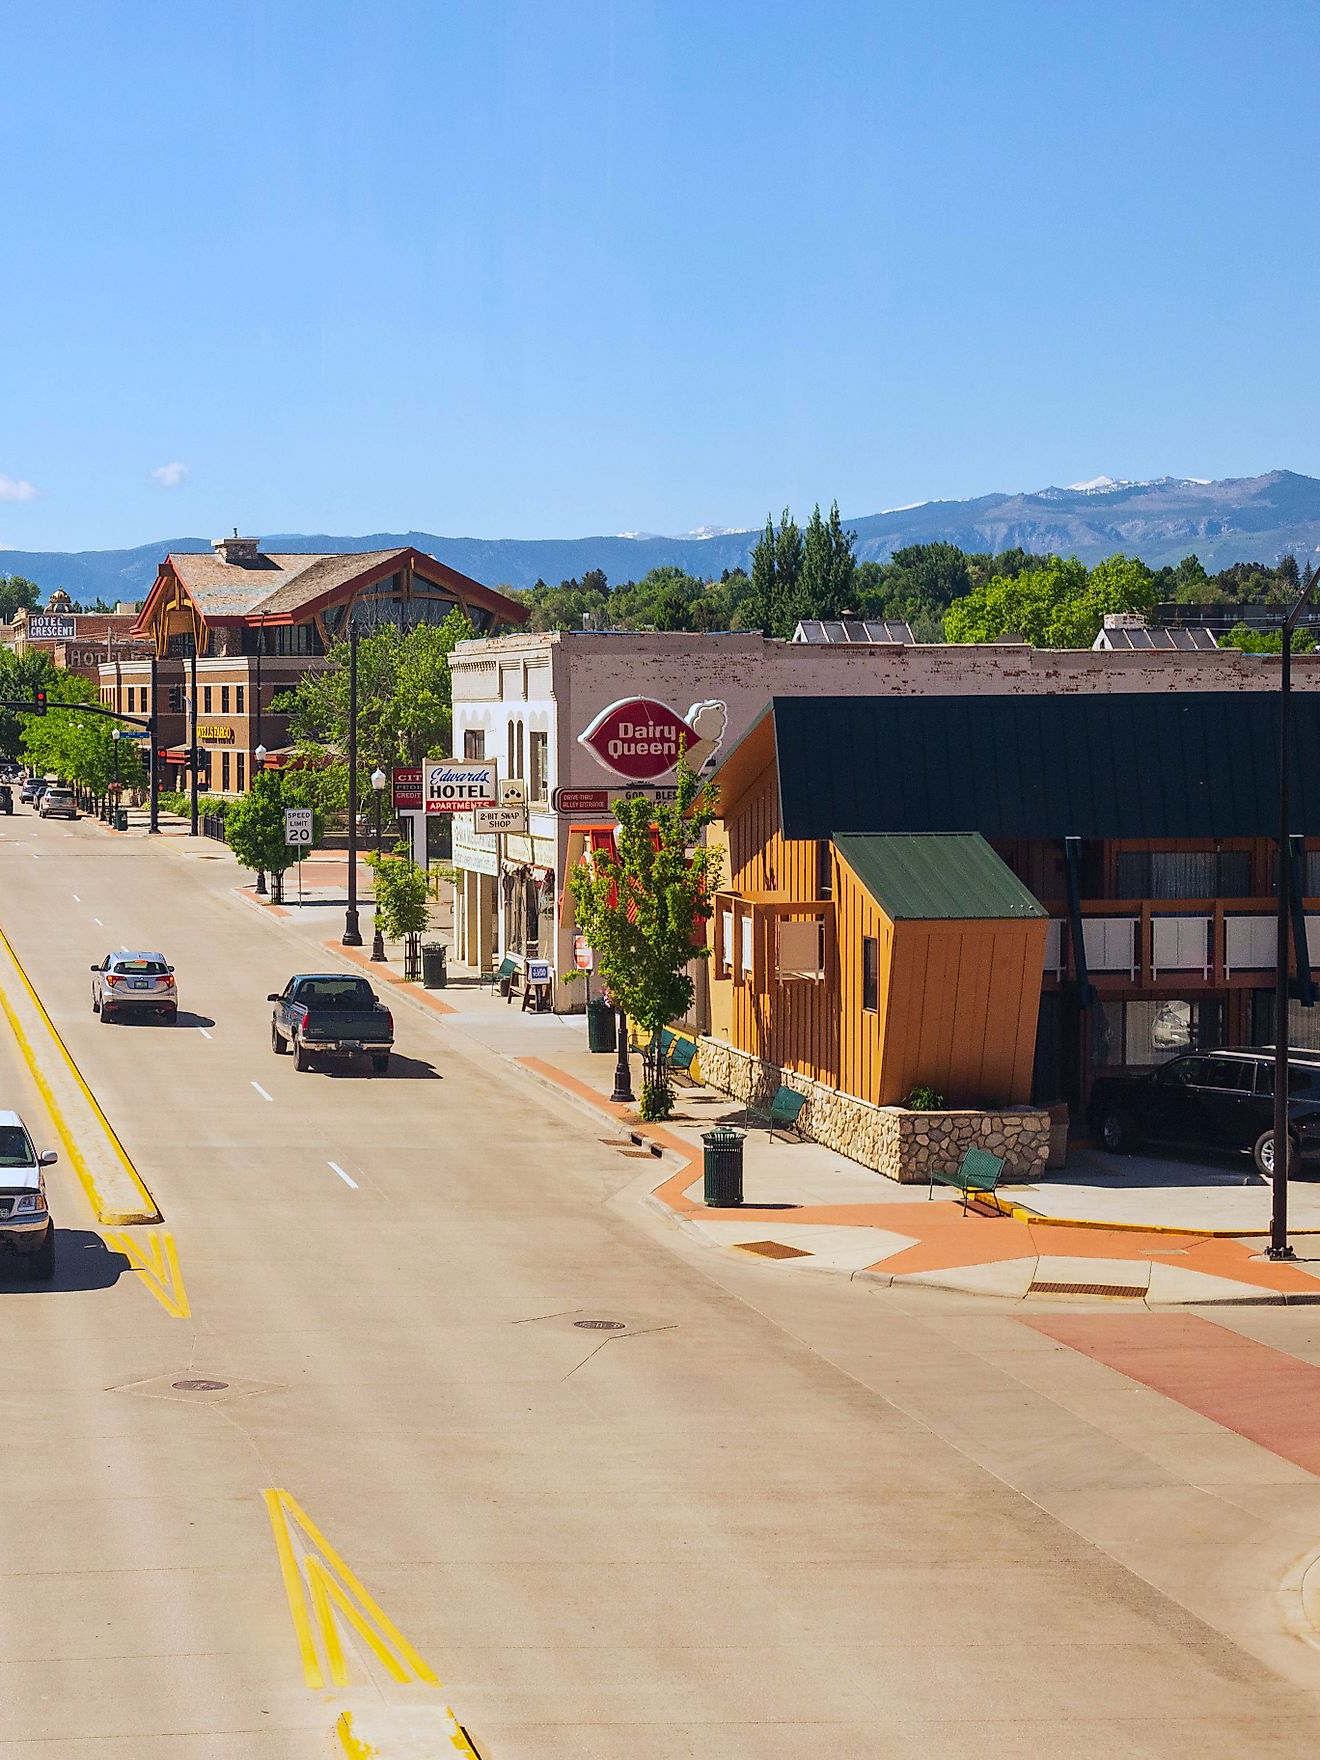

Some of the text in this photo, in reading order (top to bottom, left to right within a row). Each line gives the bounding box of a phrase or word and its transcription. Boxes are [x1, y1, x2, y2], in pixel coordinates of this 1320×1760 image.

[31, 617, 62, 626] HOTEL
[31, 627, 73, 636] CRESCENT
[196, 726, 230, 738] WELLS FARGO
[618, 720, 676, 739] Dairy
[608, 740, 676, 759] Queen
[430, 767, 489, 785] Edwards
[430, 785, 490, 798] HOTEL
[625, 791, 644, 800] GOD
[430, 801, 490, 810] APARTMENTS
[501, 812, 520, 820] SWAP
[489, 820, 511, 828] SHOP
[289, 829, 309, 840] 20
